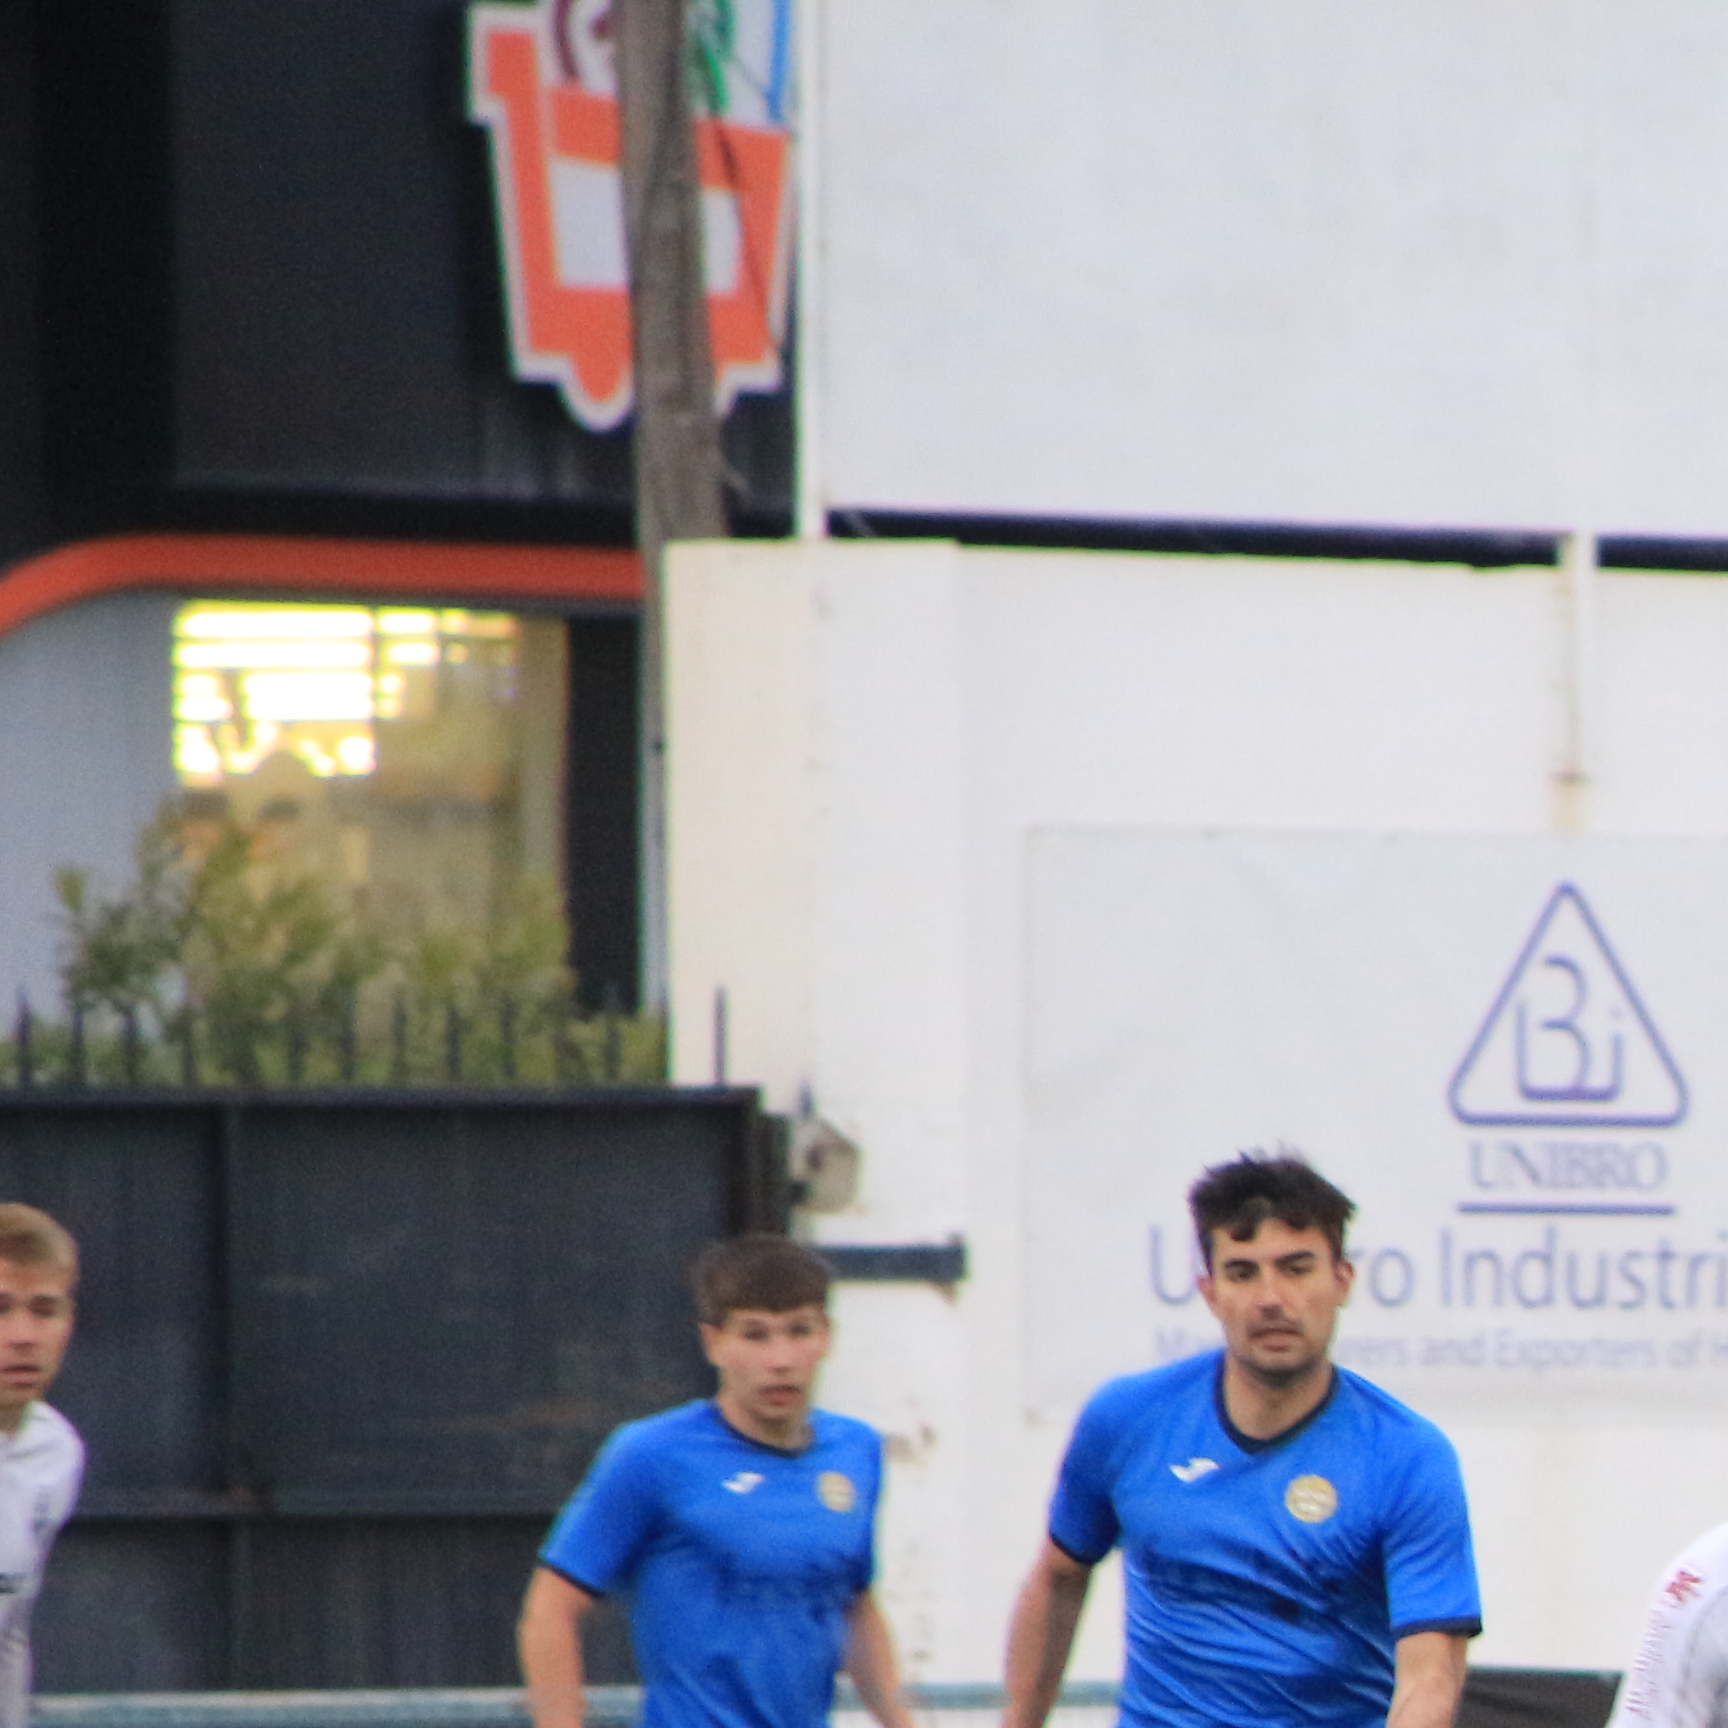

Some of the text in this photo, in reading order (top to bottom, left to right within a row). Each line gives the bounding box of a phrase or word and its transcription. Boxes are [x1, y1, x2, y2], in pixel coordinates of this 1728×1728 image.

[1468, 1140, 1670, 1191] UNIBRO
[1422, 1335, 1484, 1367] and
[1494, 1332, 1658, 1373] Exporters
[1667, 1331, 1706, 1368] of
